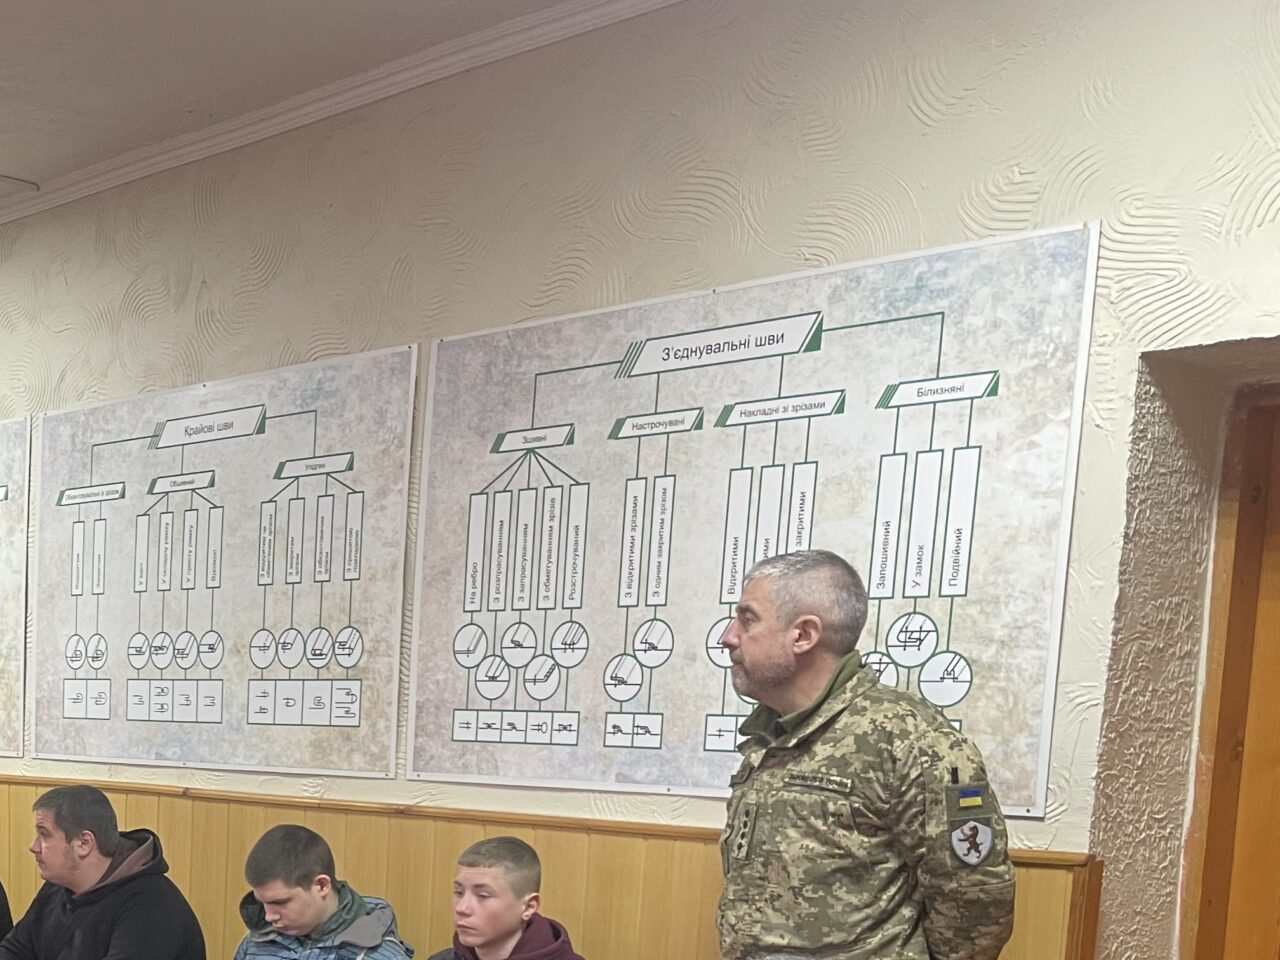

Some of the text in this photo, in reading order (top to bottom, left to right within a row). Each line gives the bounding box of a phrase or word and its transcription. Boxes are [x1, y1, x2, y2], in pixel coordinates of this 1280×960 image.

[662, 333, 784, 361] З'єднувальні шви
[740, 401, 826, 418] Накладні зі зрізами
[917, 383, 965, 397] Білизняні
[185, 421, 234, 438] Крайові шви
[631, 417, 685, 431] Настрочувані
[627, 536, 635, 589] відкритими
[631, 496, 639, 532] зрізами
[795, 491, 807, 546] закритими
[494, 520, 504, 594] розпрасуванням
[520, 524, 528, 593] запрасуванням
[568, 525, 579, 600] Розстрочуваний
[727, 536, 739, 594] Відкритими
[876, 521, 891, 589] Запошивний
[912, 545, 924, 588] У замок
[949, 528, 963, 587] Подвійний
[469, 562, 478, 604] На ребро
